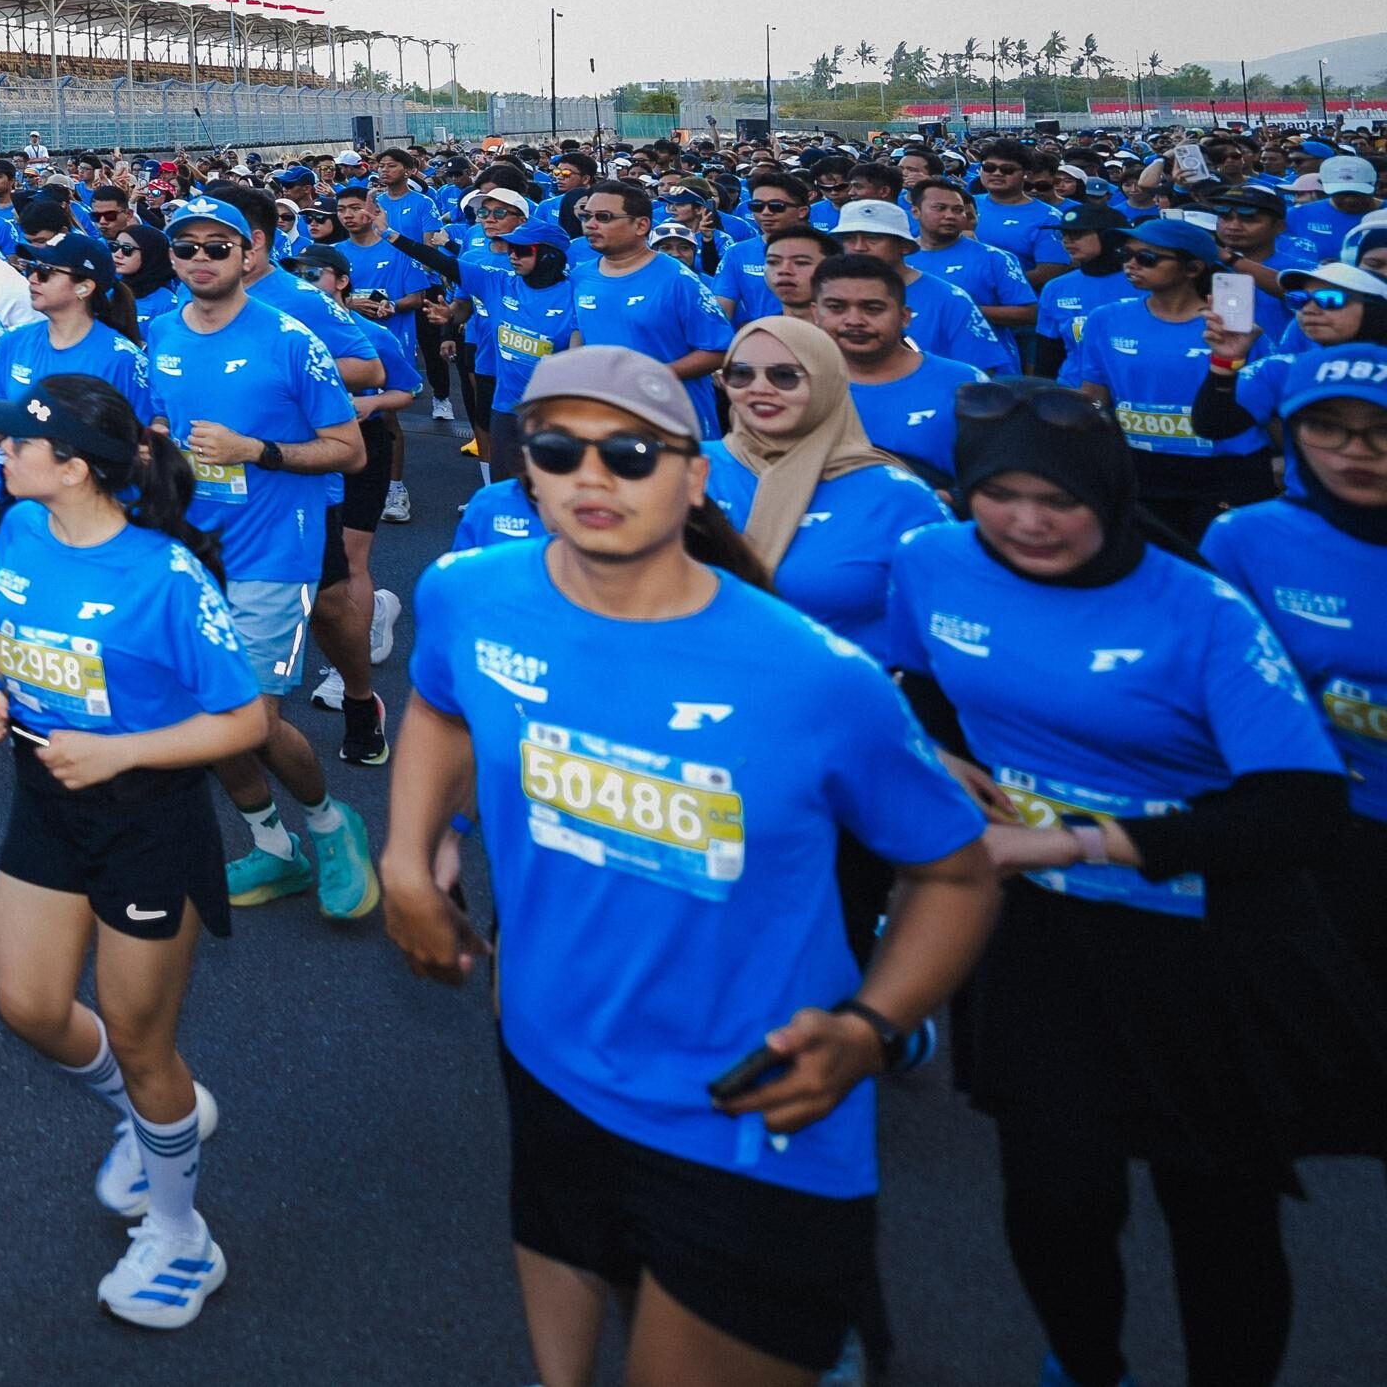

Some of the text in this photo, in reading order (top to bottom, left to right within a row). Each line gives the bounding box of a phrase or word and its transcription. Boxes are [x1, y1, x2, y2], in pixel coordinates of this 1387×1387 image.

[501, 330, 538, 354] 51801
[1117, 411, 1193, 435] 52804
[1, 640, 81, 690] 52958
[528, 749, 703, 842] 50486
